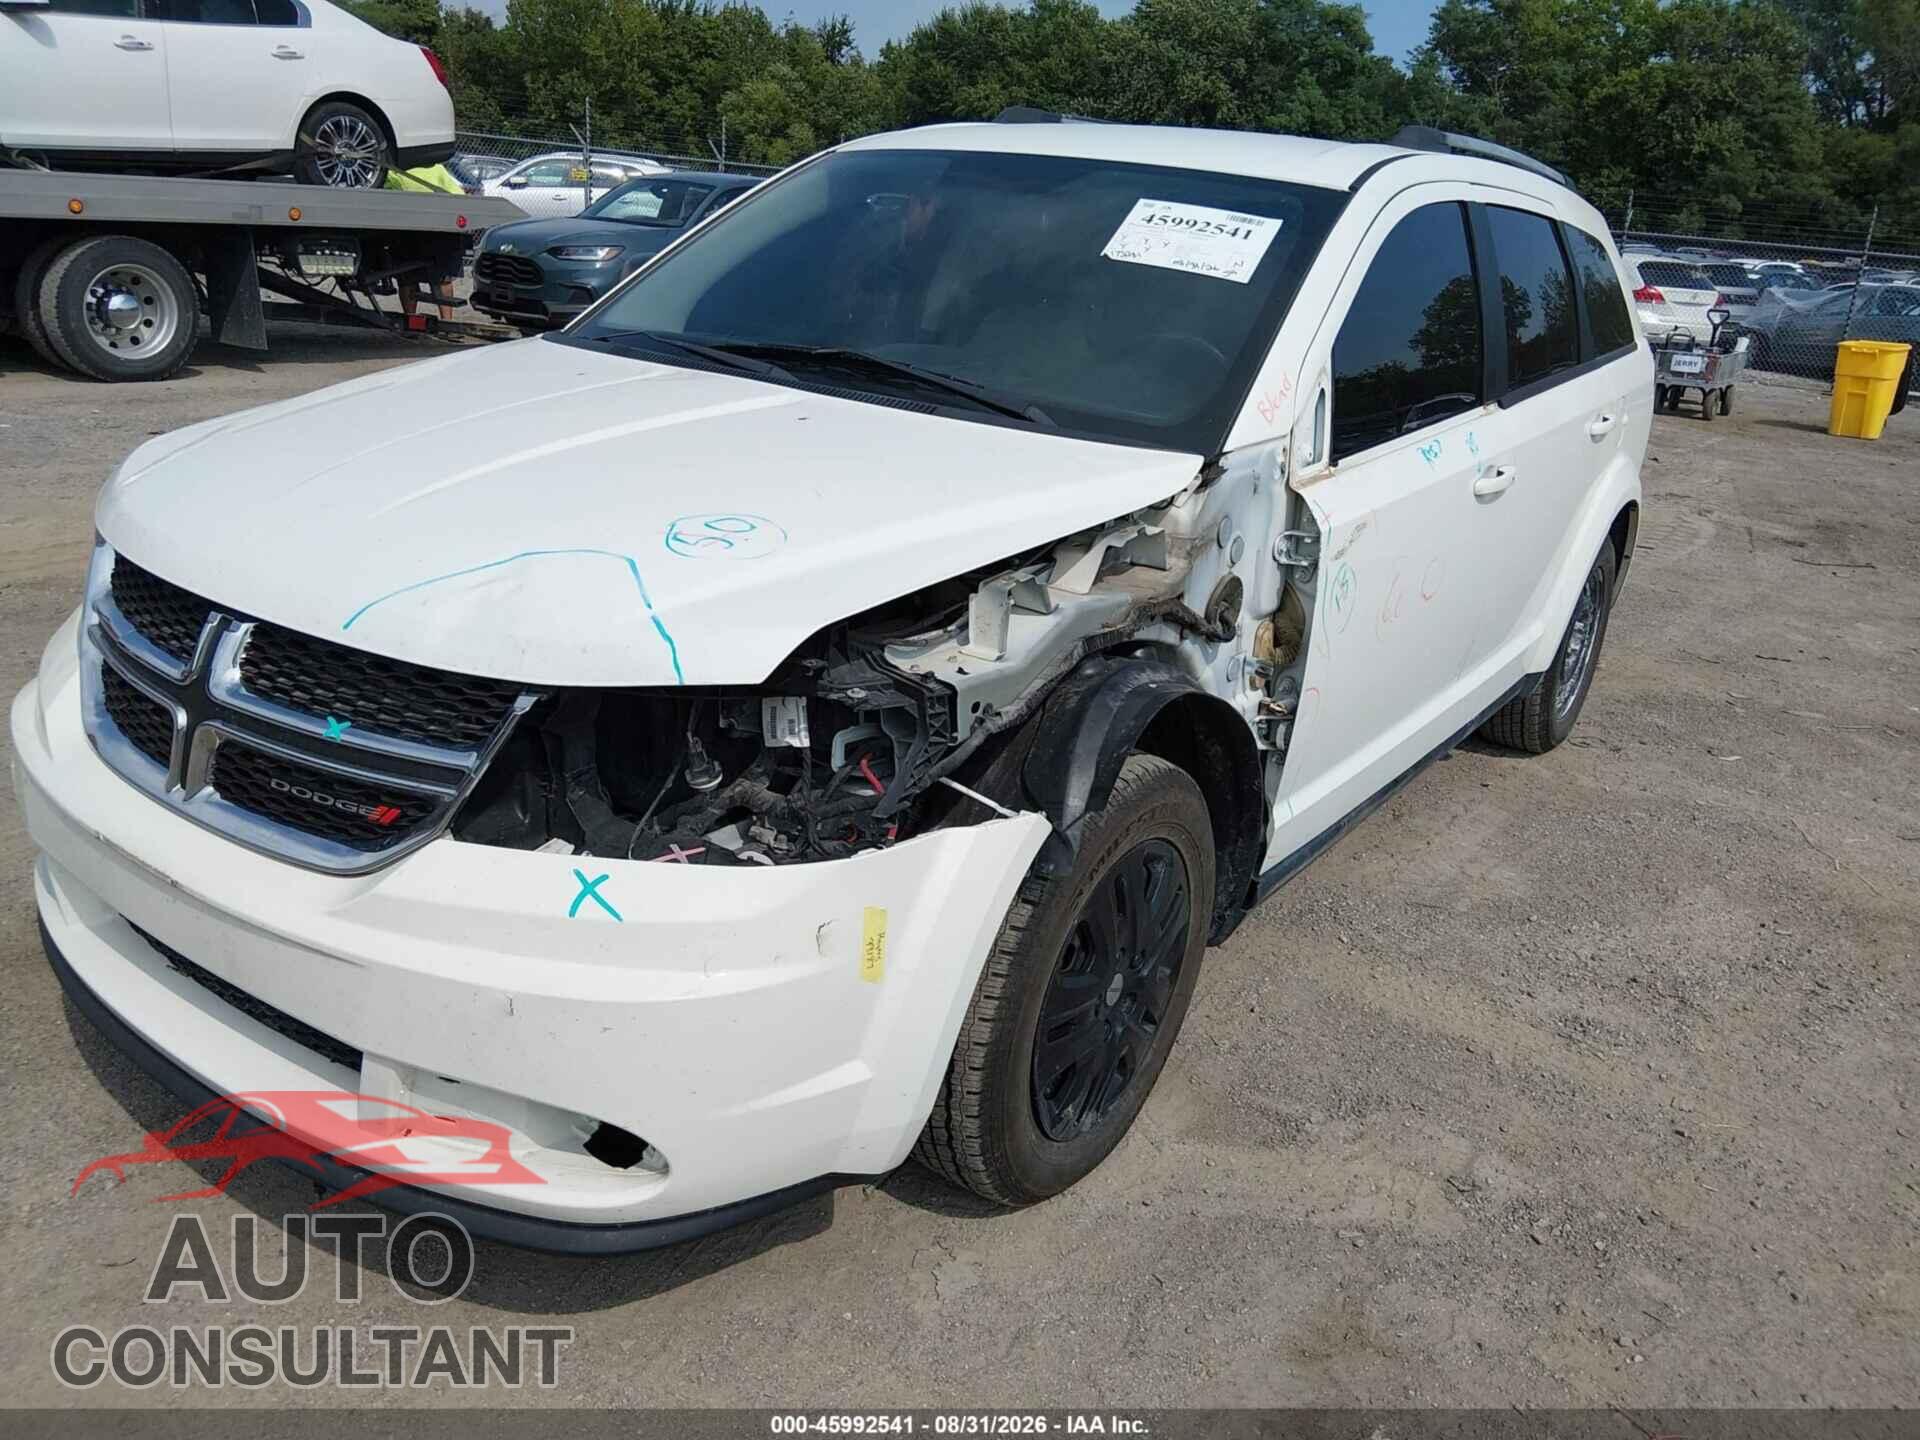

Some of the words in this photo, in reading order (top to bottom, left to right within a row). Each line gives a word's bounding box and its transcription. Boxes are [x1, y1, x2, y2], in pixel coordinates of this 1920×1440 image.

[1141, 213, 1253, 241] 45992541
[1673, 359, 1699, 369] JERRY
[269, 778, 382, 820] DODGE
